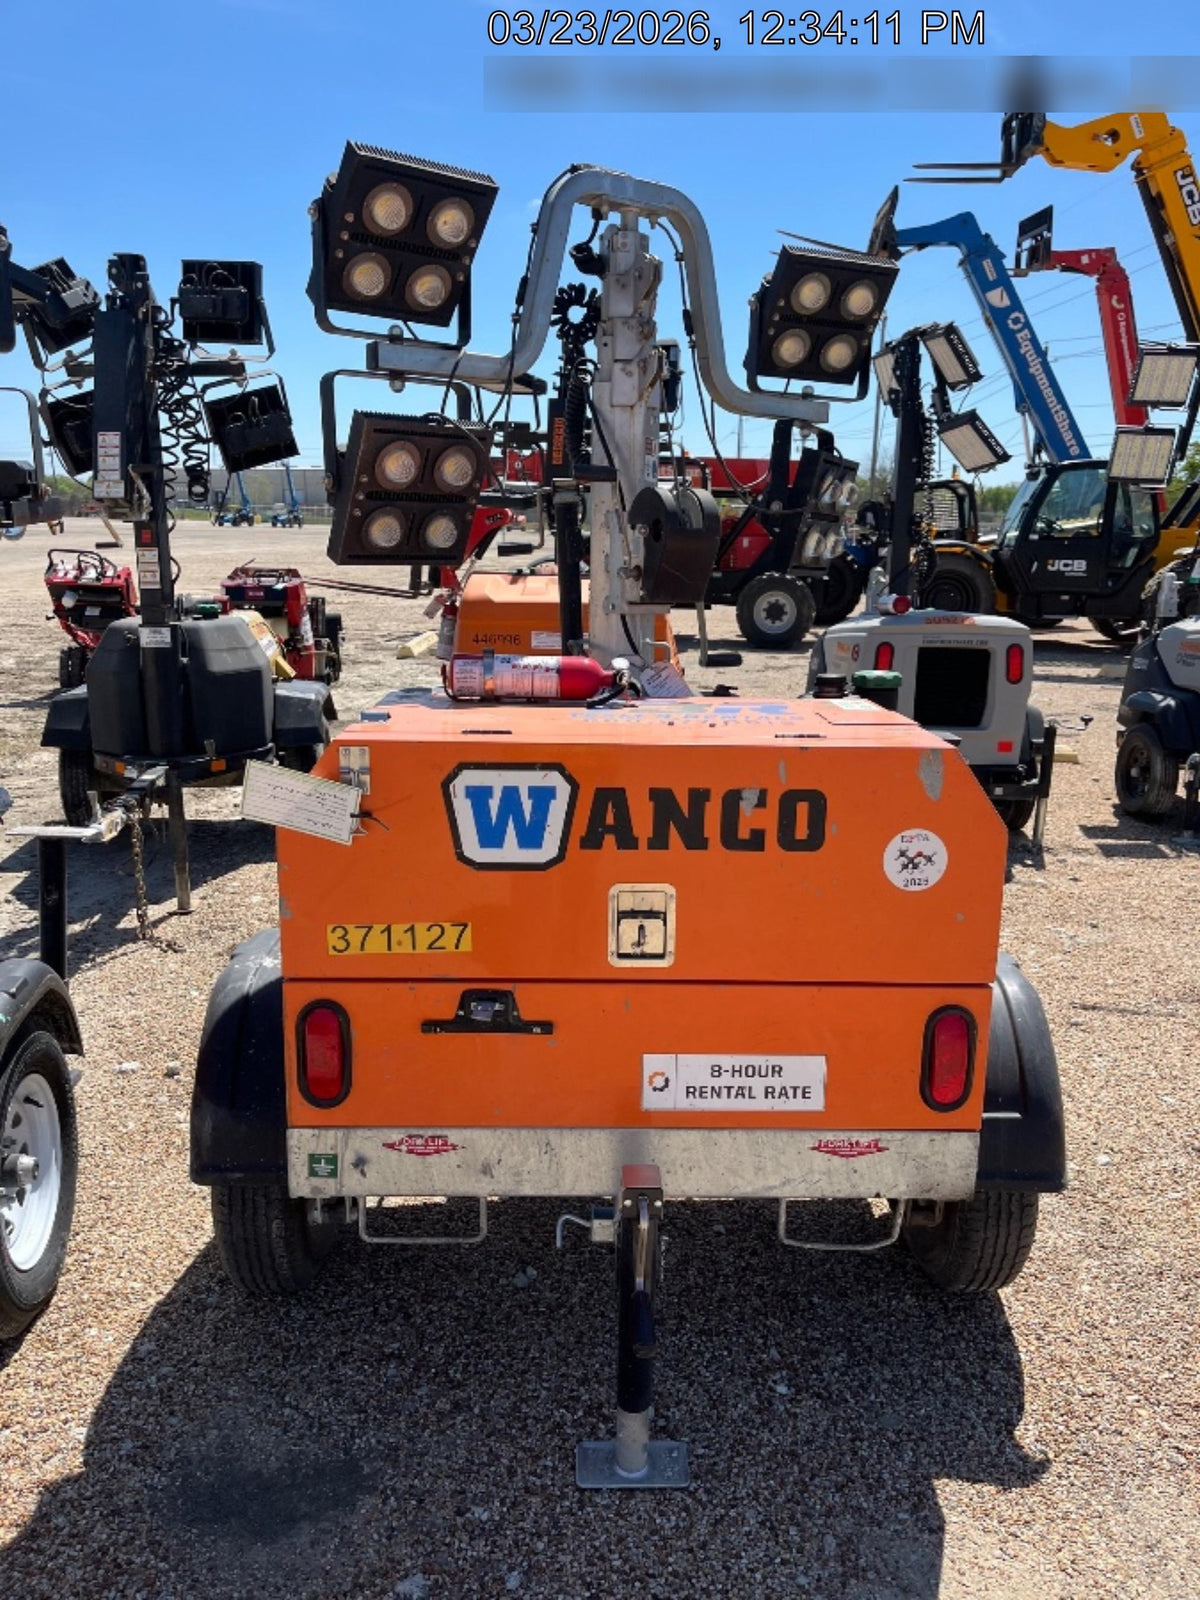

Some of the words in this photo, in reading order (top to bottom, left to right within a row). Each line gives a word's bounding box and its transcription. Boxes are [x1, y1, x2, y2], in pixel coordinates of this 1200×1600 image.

[1176, 169, 1200, 225] JCB
[1015, 328, 1081, 457] EquipmentShare
[1047, 559, 1088, 572] JCB
[464, 785, 828, 852] WANCO
[330, 923, 469, 953] 371127
[710, 1064, 784, 1079] 8-HOUR
[685, 1085, 757, 1100] RENTAL
[763, 1085, 812, 1100] RATE
